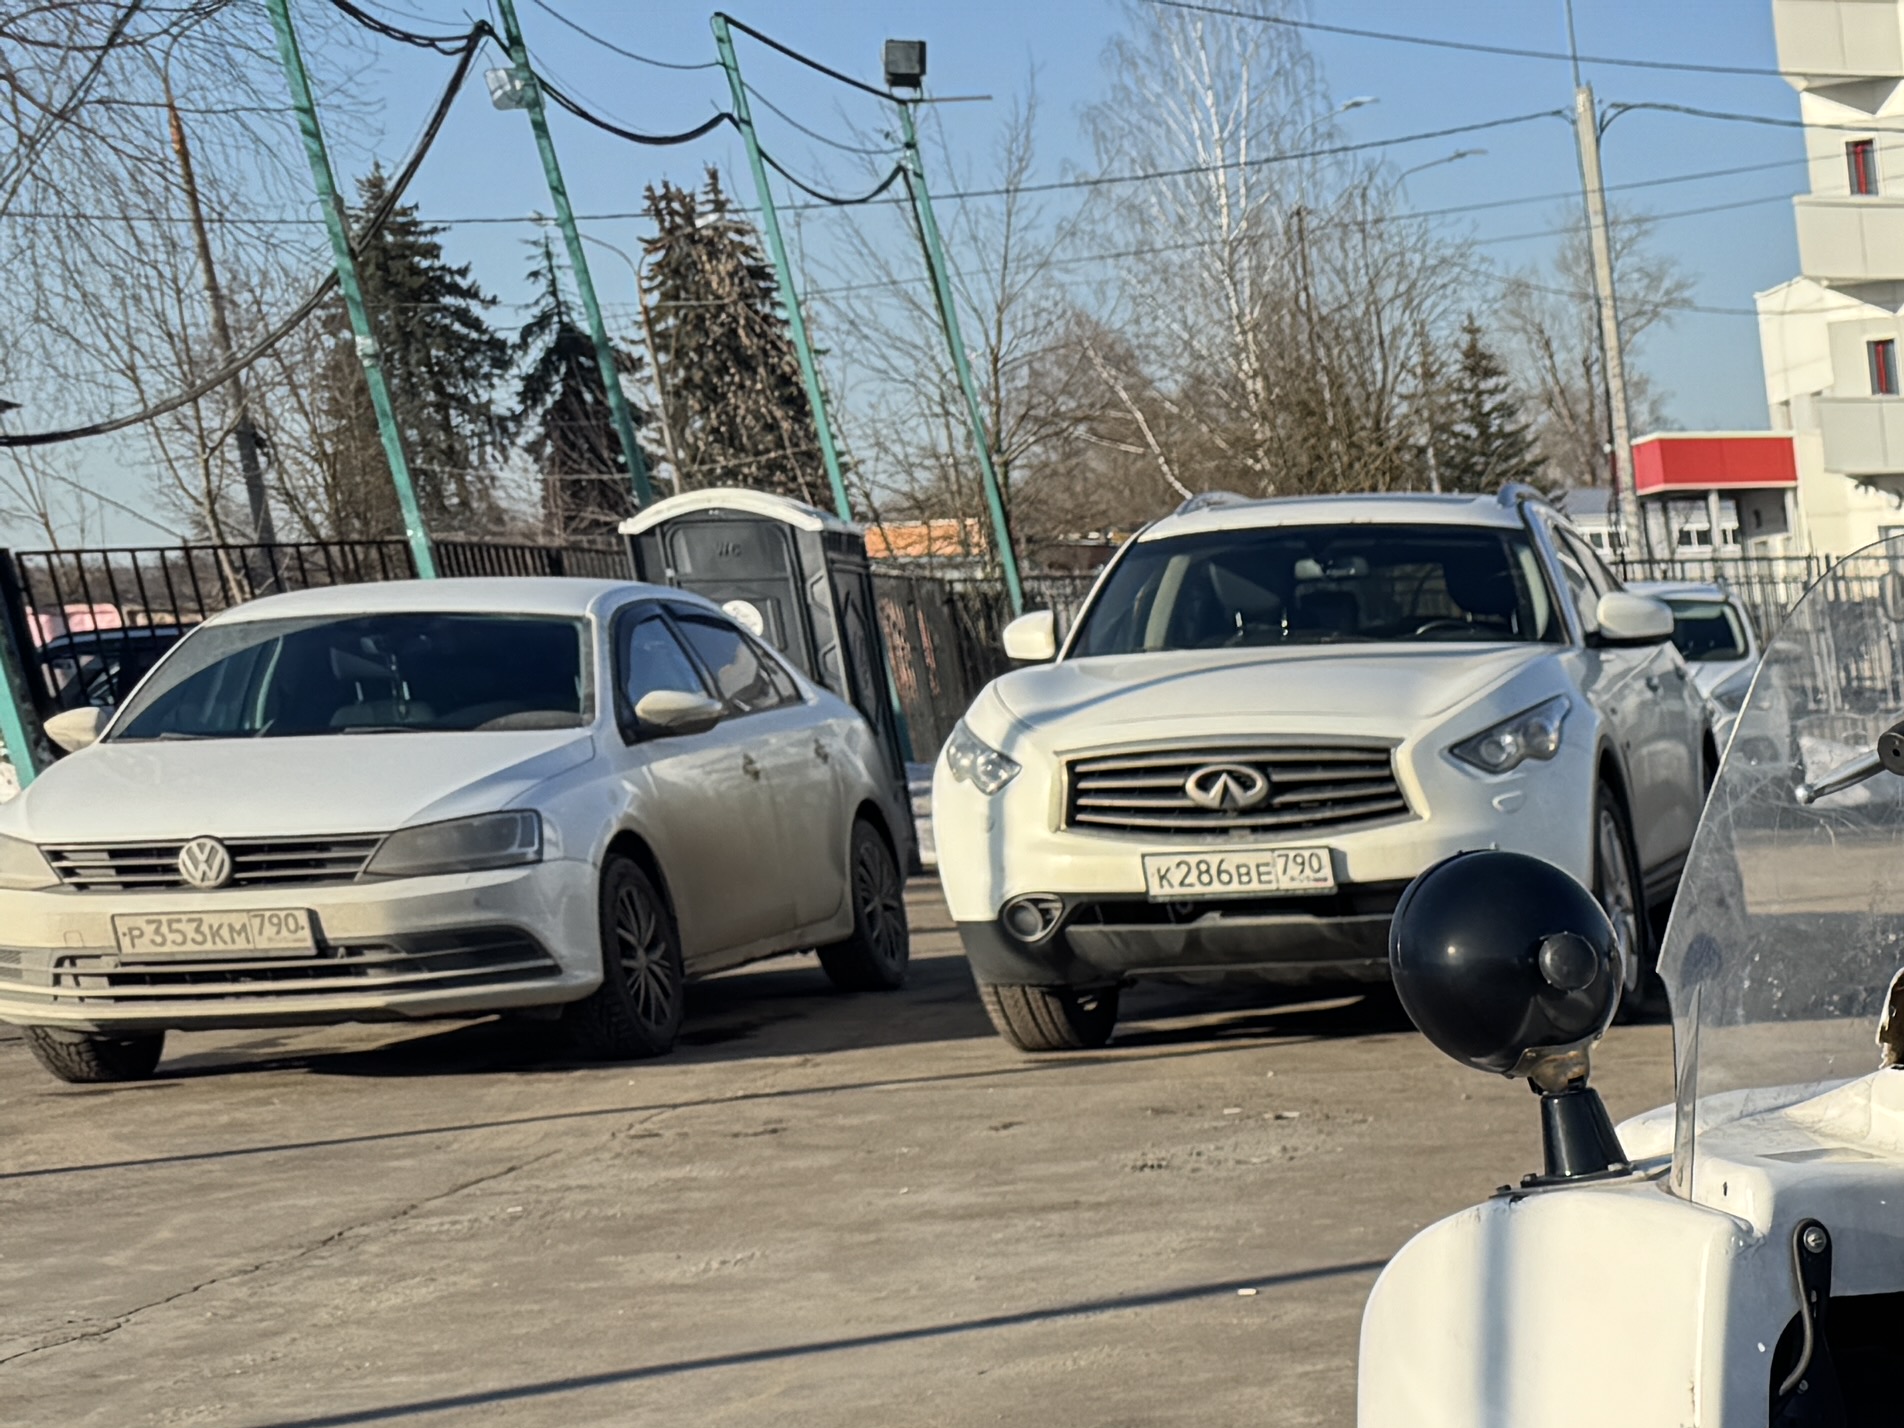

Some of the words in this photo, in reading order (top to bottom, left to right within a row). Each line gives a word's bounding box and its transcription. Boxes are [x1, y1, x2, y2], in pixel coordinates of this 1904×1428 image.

[1156, 858, 1273, 889] К286ВЕ
[1277, 852, 1322, 876] 790
[127, 916, 252, 949] Р353КМ
[251, 912, 299, 936] 790
